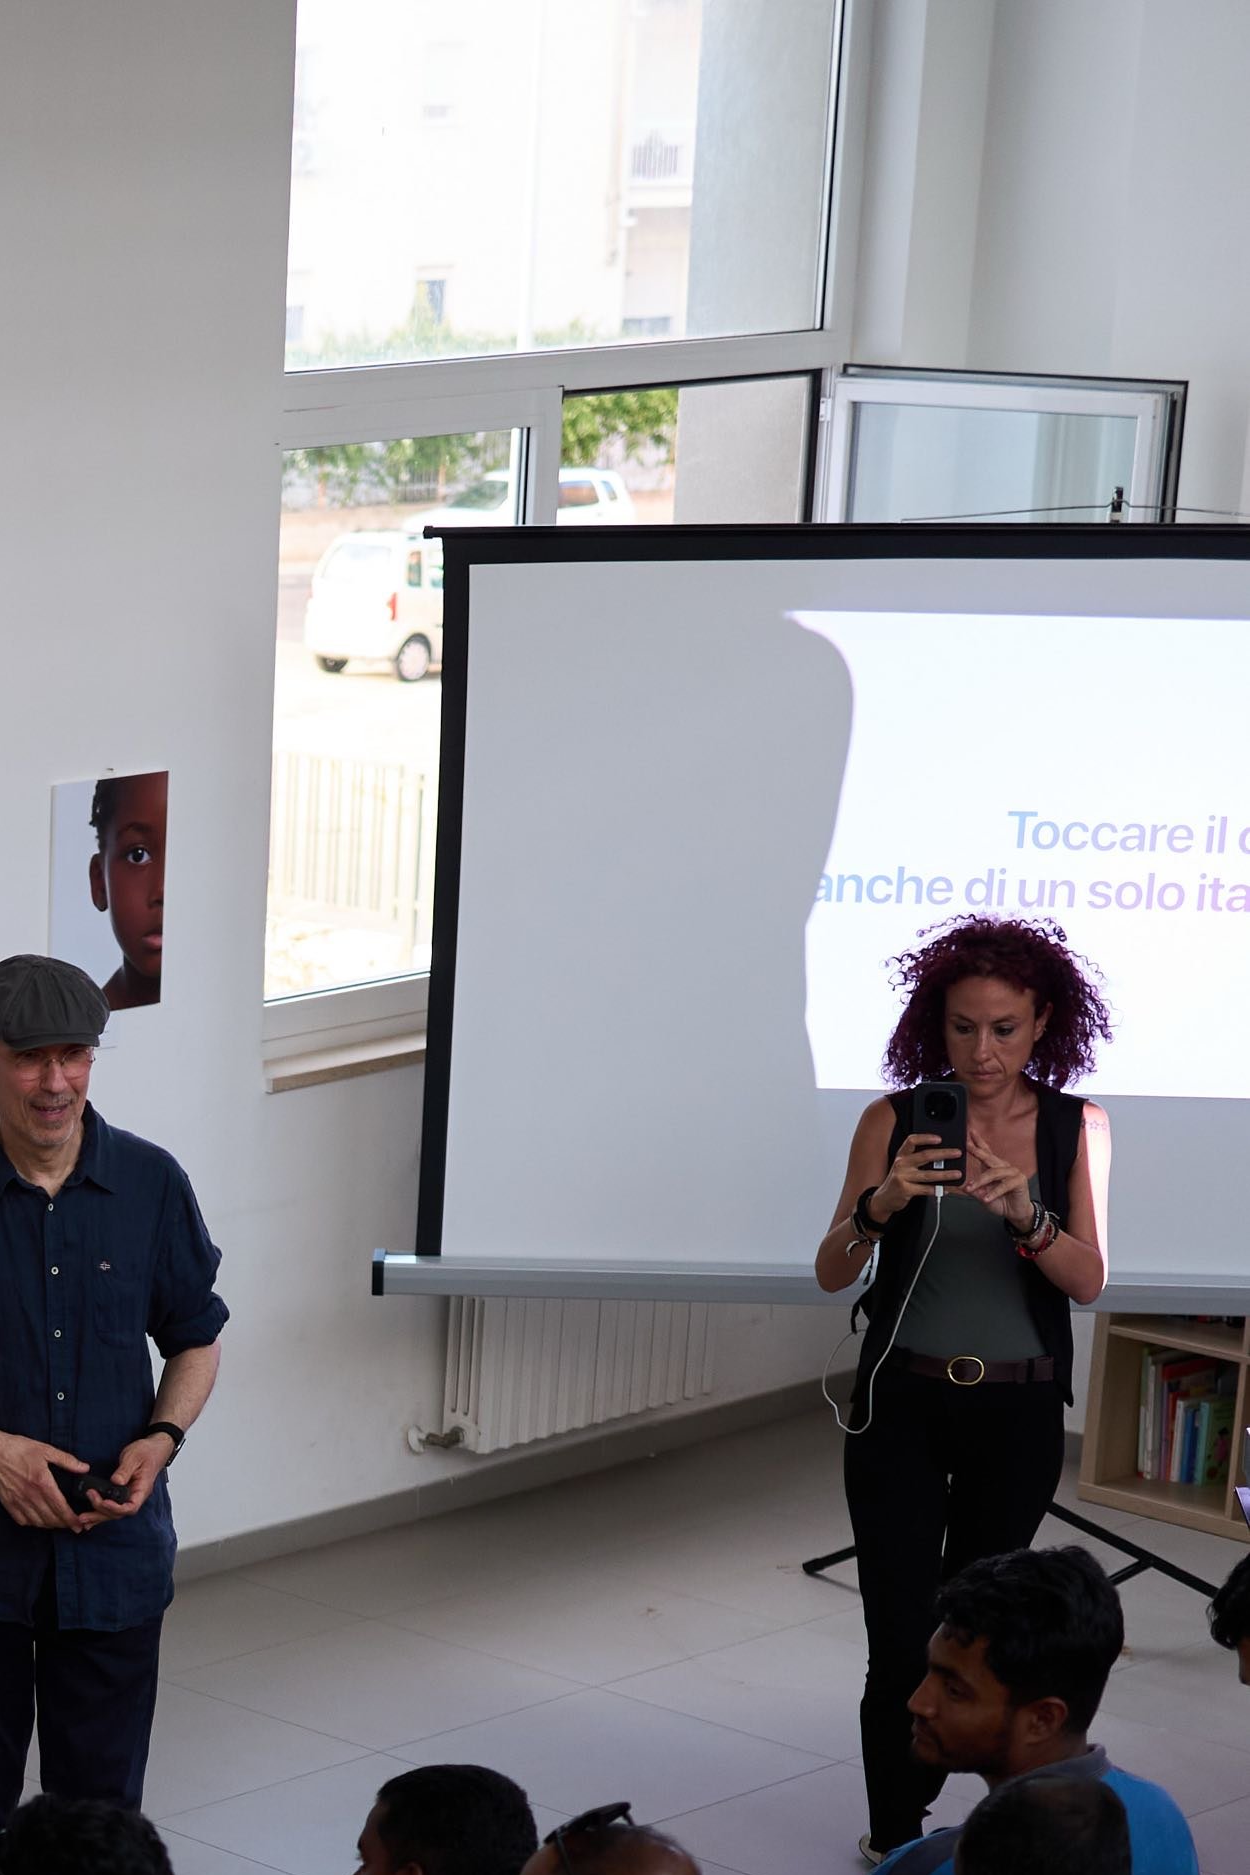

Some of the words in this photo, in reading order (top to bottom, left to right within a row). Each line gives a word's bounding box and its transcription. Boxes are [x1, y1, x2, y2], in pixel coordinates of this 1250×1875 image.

[1007, 810, 1195, 853] Toccare
[1204, 814, 1229, 855] il
[813, 865, 954, 906] anche
[964, 866, 1008, 908] di
[1017, 877, 1076, 909] un
[1086, 872, 1186, 912] solo
